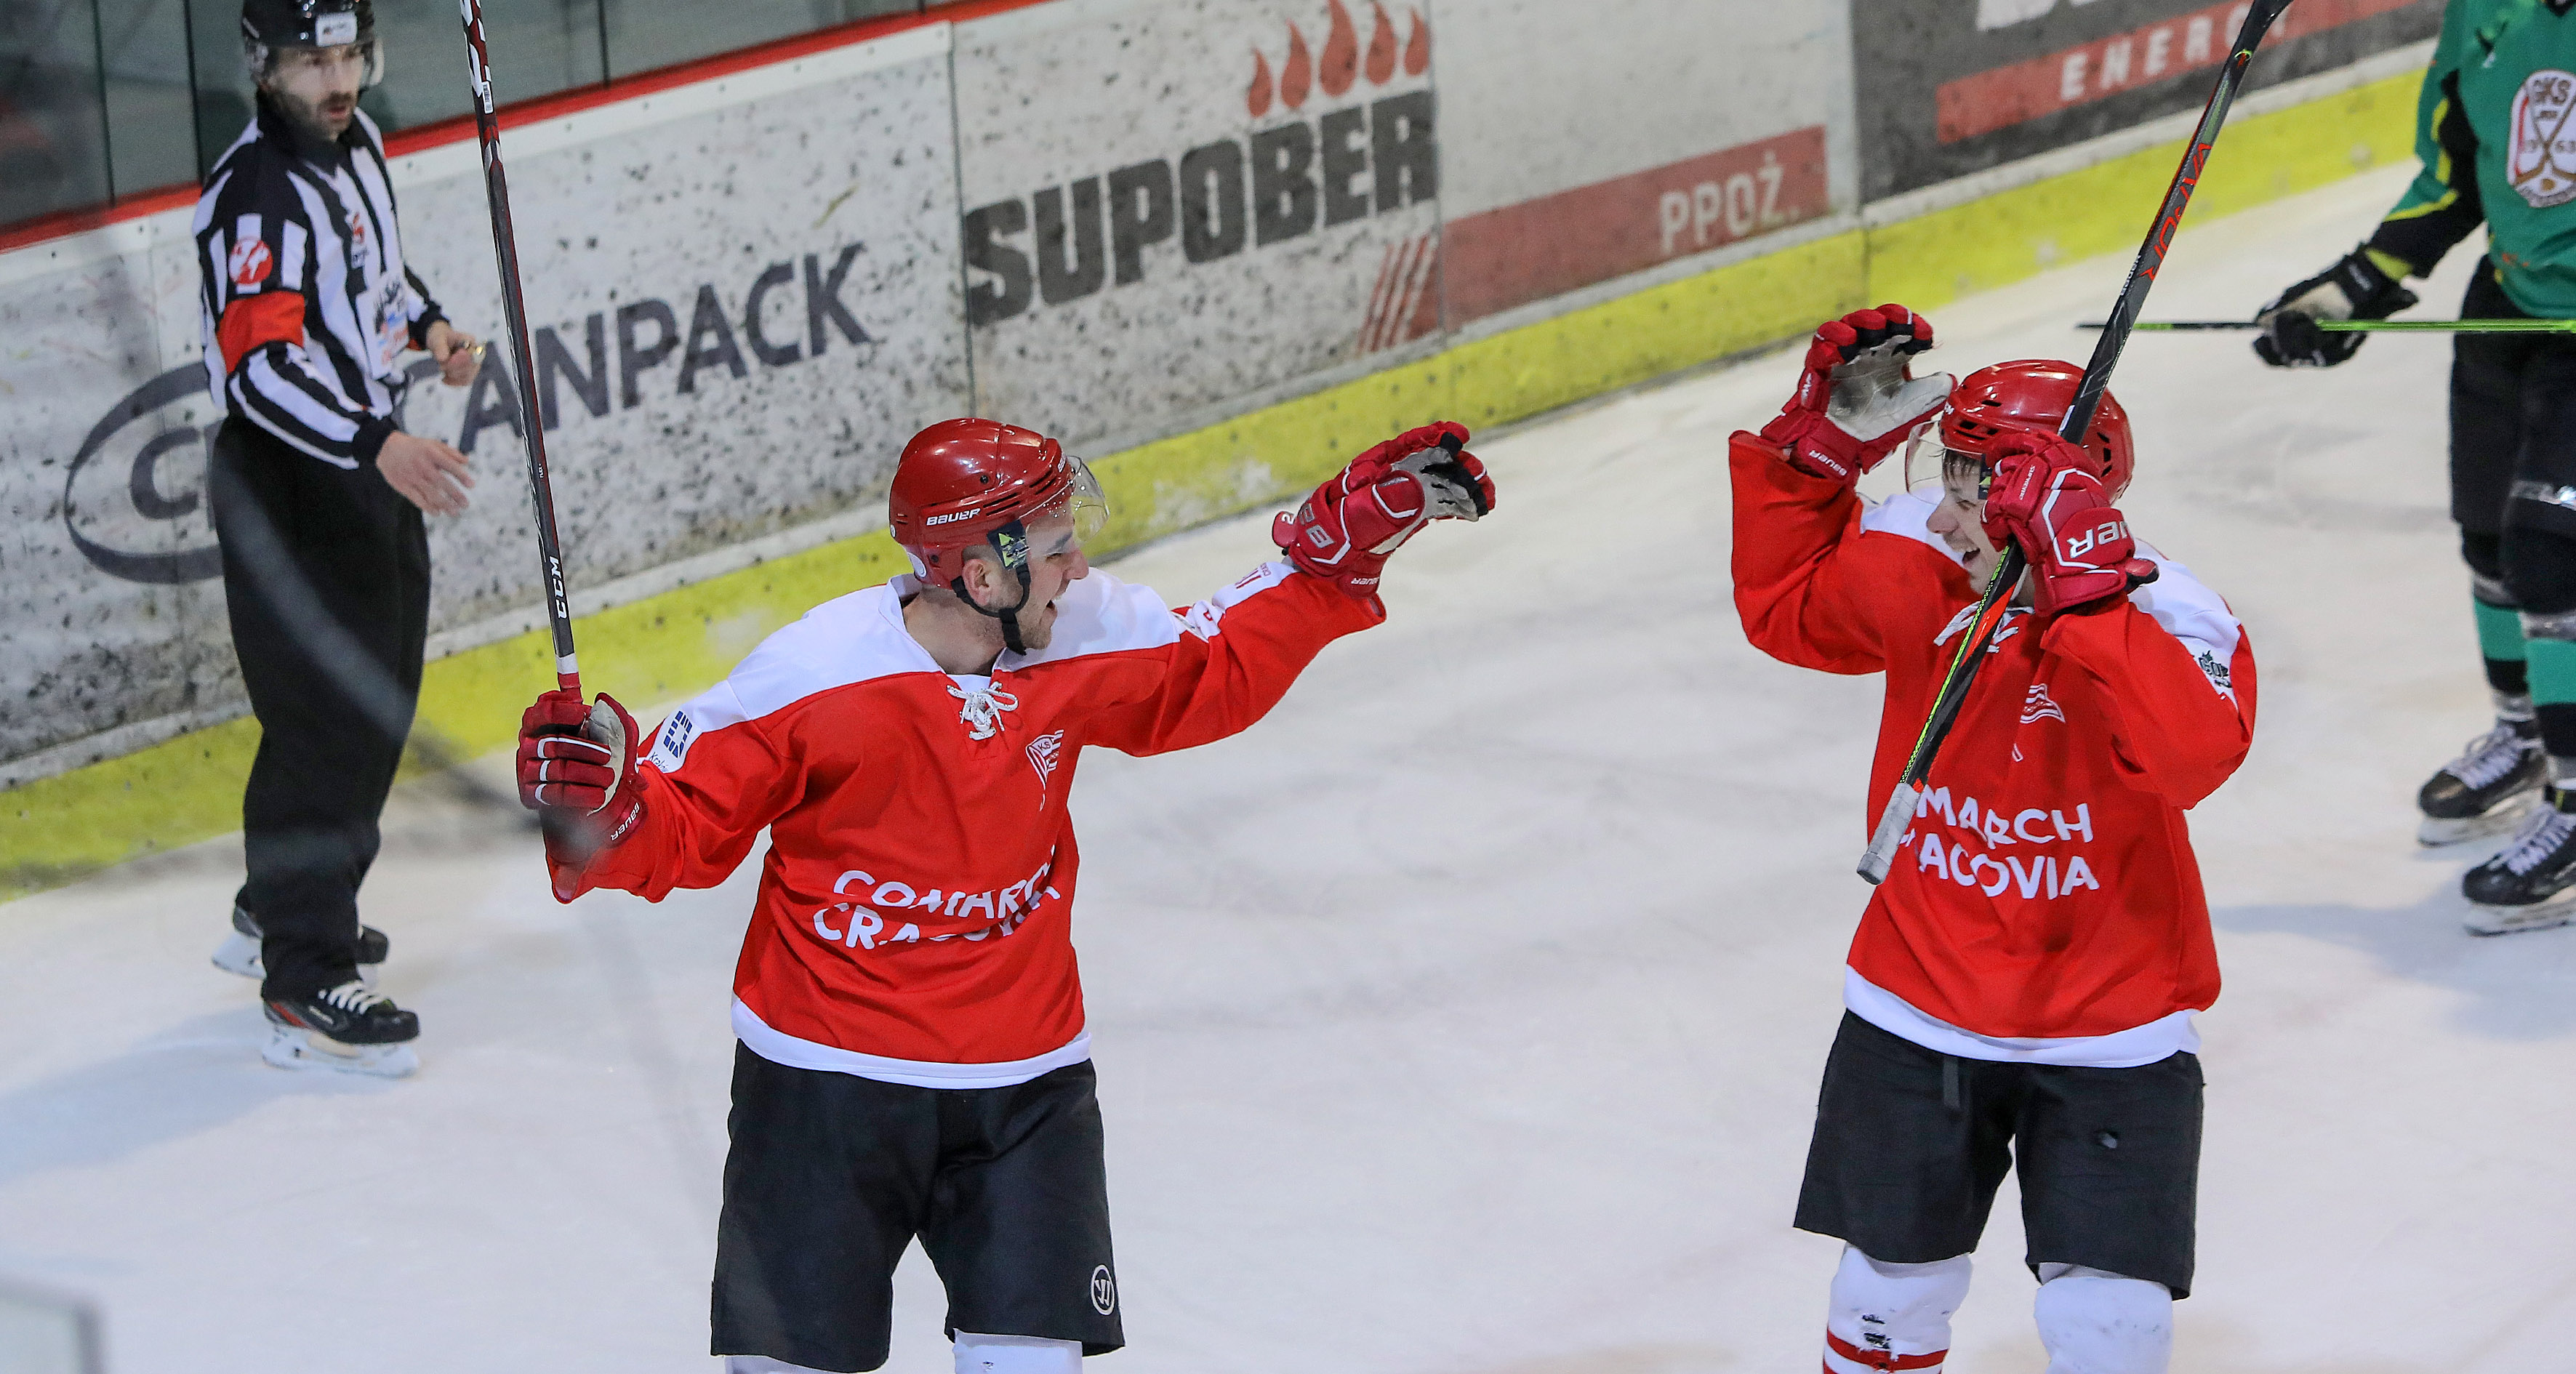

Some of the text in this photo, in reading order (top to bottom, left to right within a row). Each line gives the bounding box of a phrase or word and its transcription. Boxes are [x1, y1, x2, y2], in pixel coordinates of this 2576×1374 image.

[965, 89, 1437, 327] SUPOBER
[1658, 151, 1800, 254] PPOŻ.
[926, 507, 981, 526] BAUER
[2067, 521, 2128, 558] UER
[549, 556, 568, 619] CCM
[610, 802, 640, 841] BAUER
[1916, 784, 2094, 850] MARCH
[1899, 827, 2100, 901] ACOVIA
